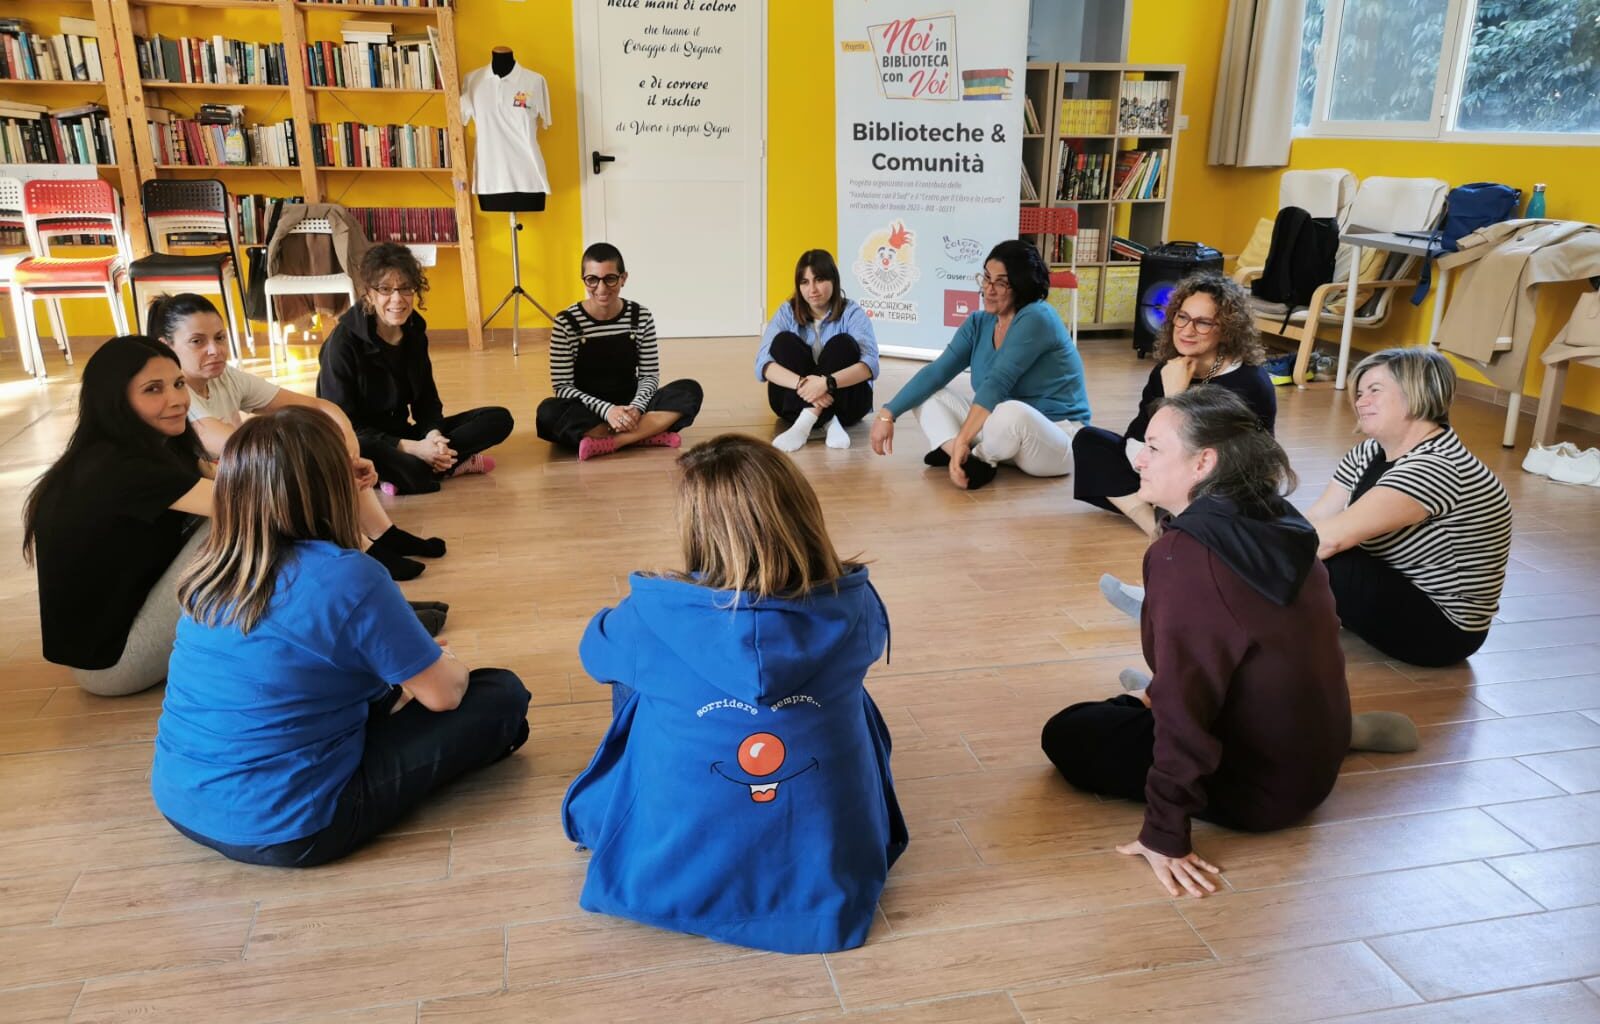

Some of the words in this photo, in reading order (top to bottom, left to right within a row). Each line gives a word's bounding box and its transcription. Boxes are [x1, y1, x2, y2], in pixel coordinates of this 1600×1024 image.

[607, 0, 639, 8] nelle
[645, 0, 679, 9] mani
[683, 0, 695, 10] di
[699, 0, 737, 12] coloro
[644, 25, 658, 35] che
[662, 25, 689, 36] hanno
[693, 26, 700, 37] il
[882, 17, 935, 55] Noi
[935, 38, 947, 51] in
[623, 39, 667, 58] Coraggio
[670, 42, 680, 53] di
[683, 41, 722, 60] Sognare
[882, 54, 949, 68] BIBLIOTECA
[639, 80, 646, 88] e
[650, 75, 662, 88] di
[666, 80, 709, 90] correre
[882, 71, 903, 82] con
[908, 68, 949, 97] Voi
[647, 94, 657, 106] il
[661, 93, 701, 107] rischio
[615, 121, 626, 132] di
[630, 120, 663, 136] Vivere
[672, 123, 700, 137] propri
[703, 121, 731, 139] Sogni
[852, 121, 985, 143] Biblioteche
[990, 123, 1006, 143] &
[871, 152, 984, 173] Comunità
[860, 299, 913, 311] ASSOCIAZIONE
[888, 311, 917, 321] TERAPIA
[696, 698, 758, 718] sorridere
[770, 694, 822, 712] sempre...
